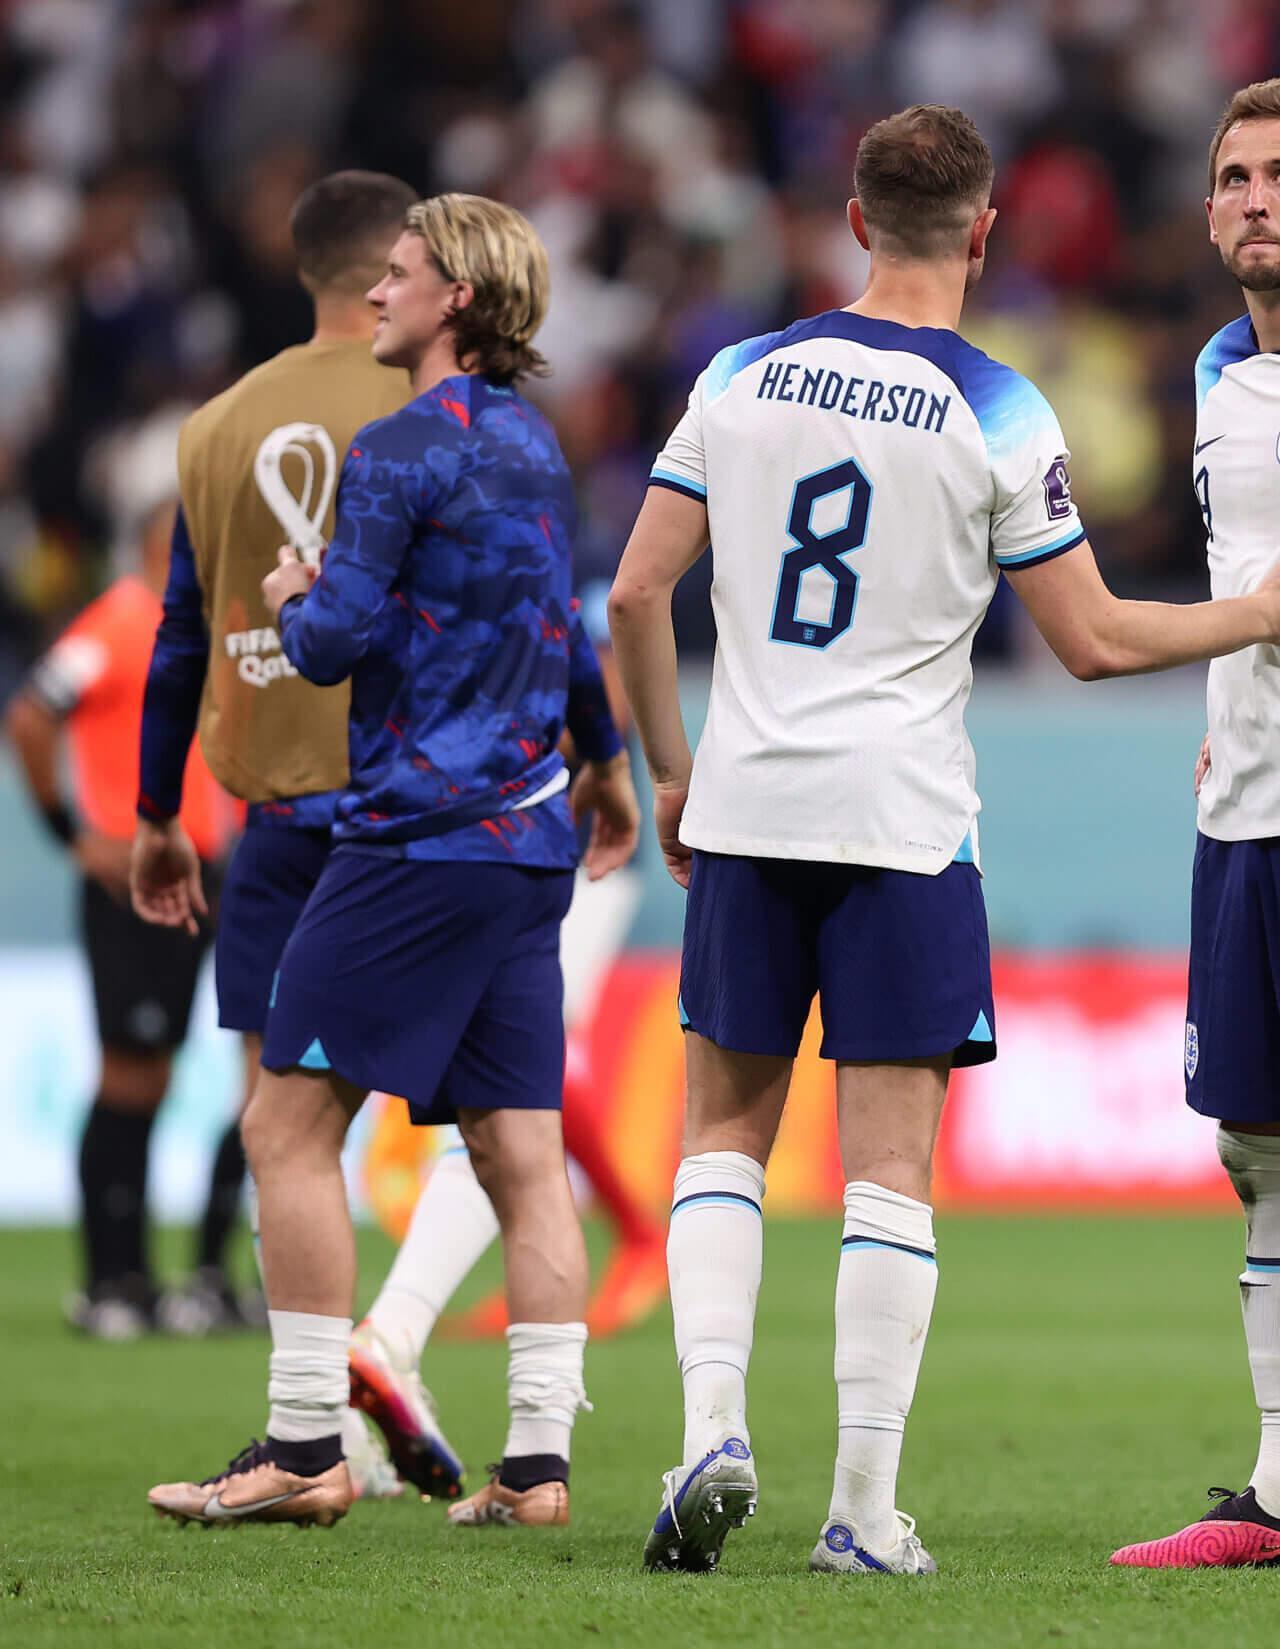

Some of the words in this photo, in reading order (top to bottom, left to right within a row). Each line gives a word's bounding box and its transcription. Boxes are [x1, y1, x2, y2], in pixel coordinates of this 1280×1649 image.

[757, 362, 951, 433] HENDERSON
[769, 456, 874, 651] 8
[225, 627, 281, 656] FIFA
[238, 653, 298, 688] Qat
